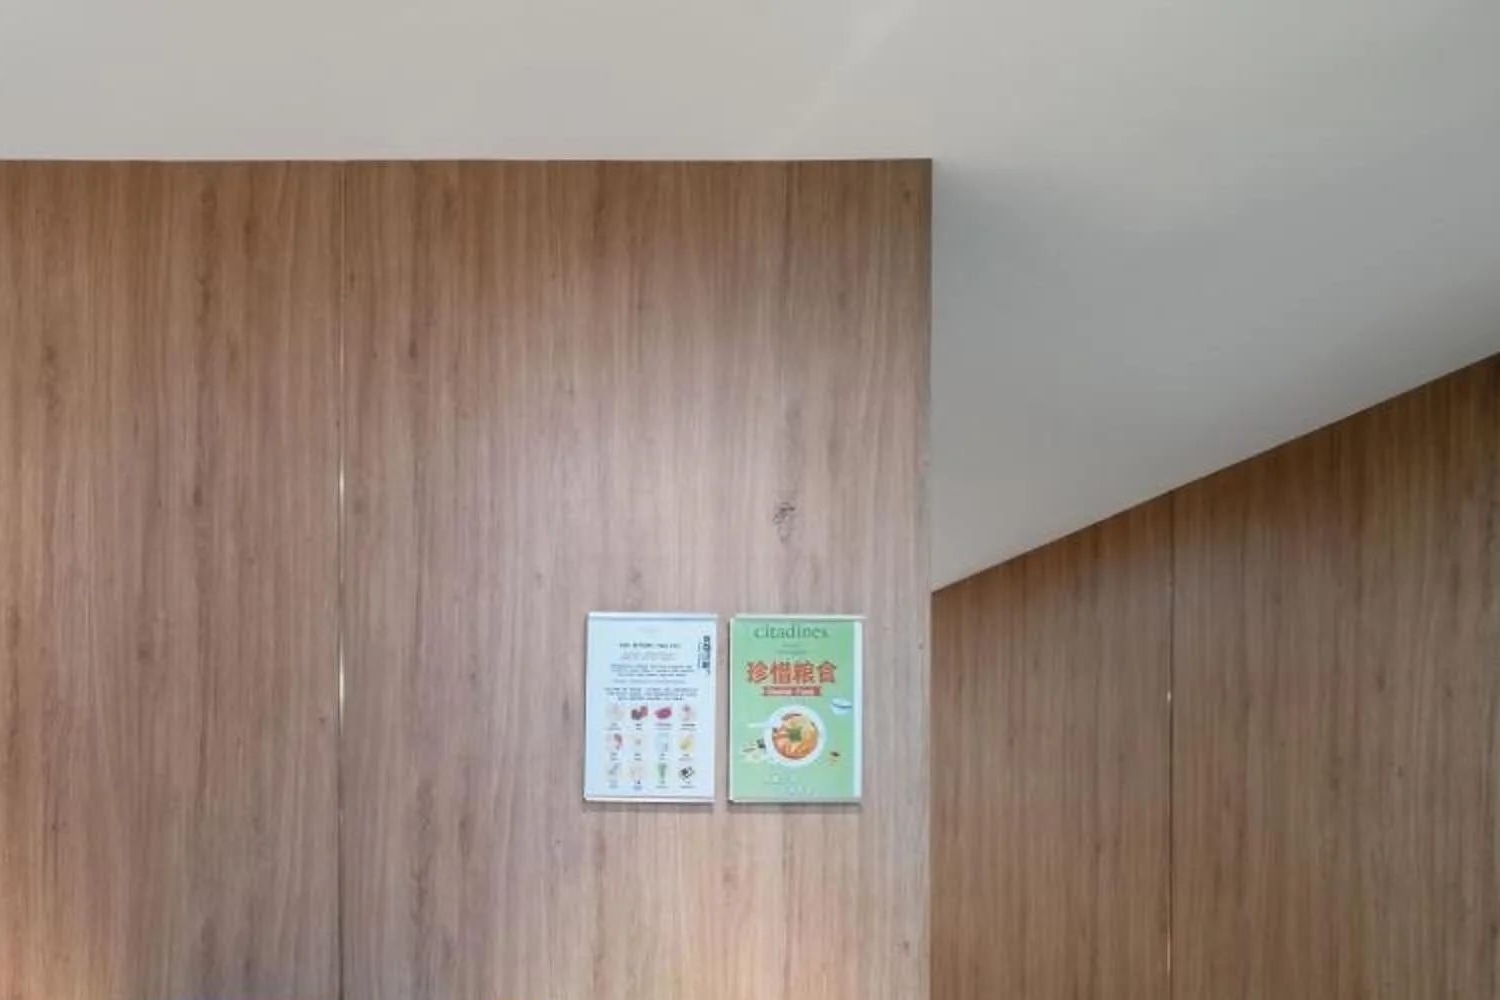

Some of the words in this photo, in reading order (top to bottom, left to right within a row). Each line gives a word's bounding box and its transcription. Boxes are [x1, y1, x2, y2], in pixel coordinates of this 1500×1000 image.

[753, 624, 829, 639] citadines
[745, 660, 837, 684] 珍惜粮食
